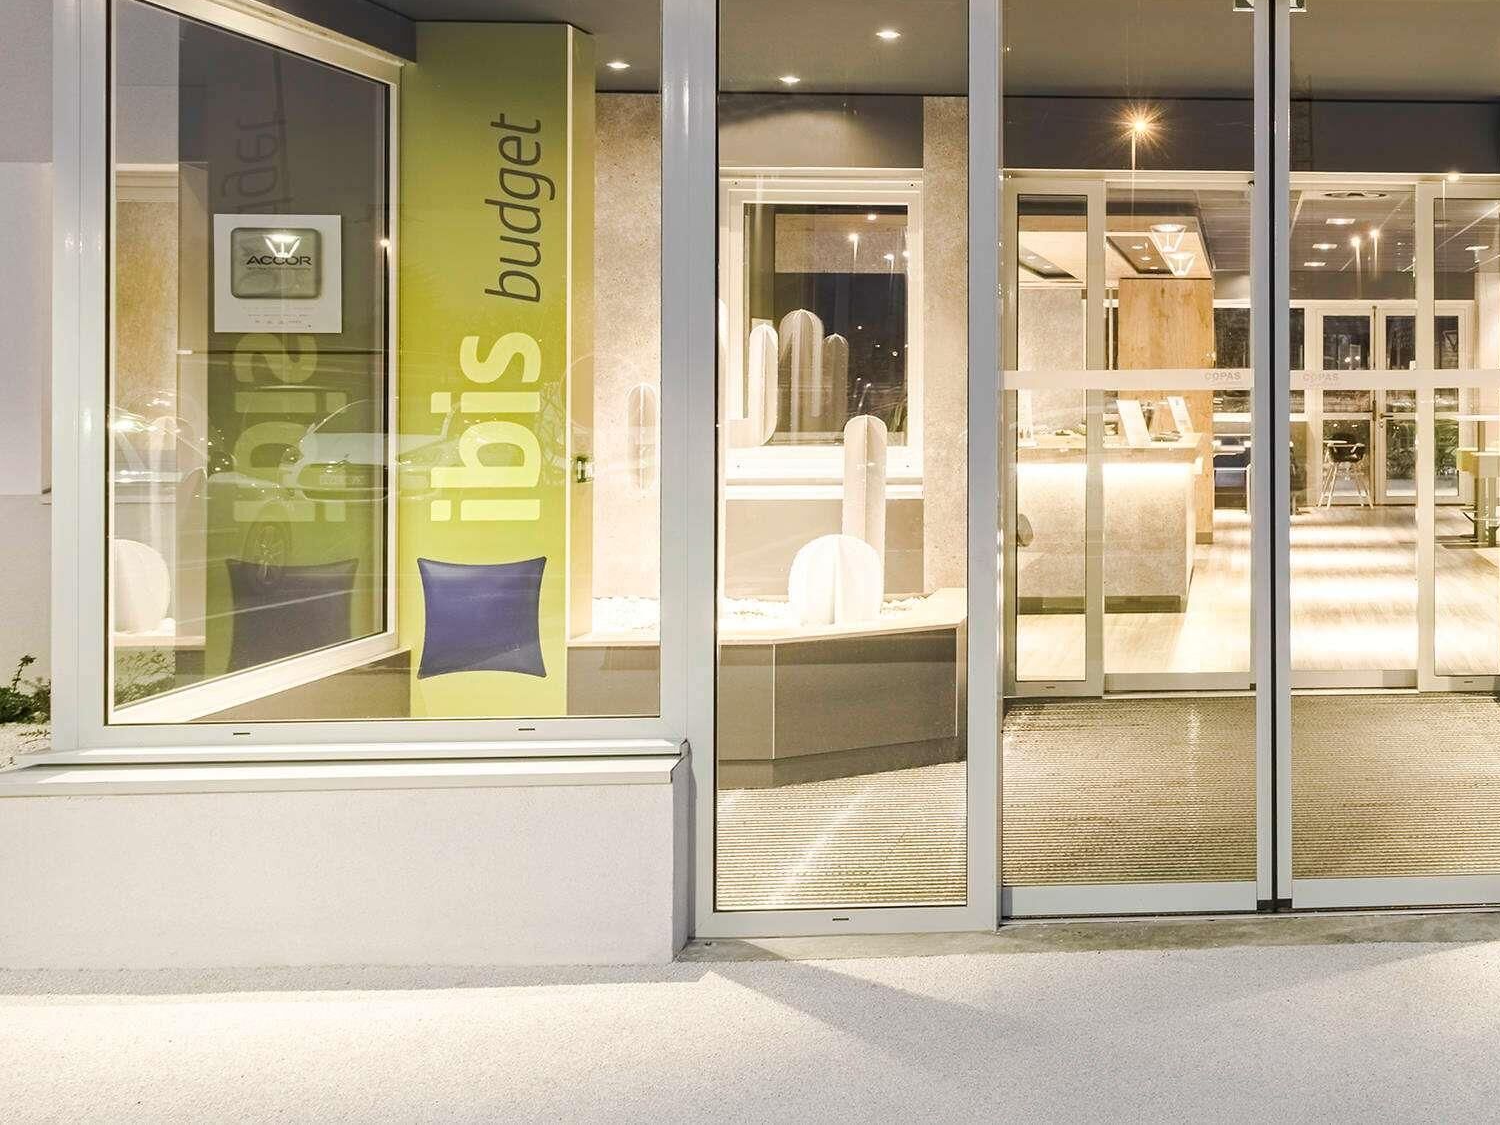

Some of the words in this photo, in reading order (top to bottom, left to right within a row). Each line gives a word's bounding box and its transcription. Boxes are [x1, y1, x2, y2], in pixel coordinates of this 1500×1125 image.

[484, 113, 556, 303] budget
[246, 255, 313, 266] ACCOR
[1204, 371, 1241, 381] COPAS
[430, 331, 542, 522] ibis
